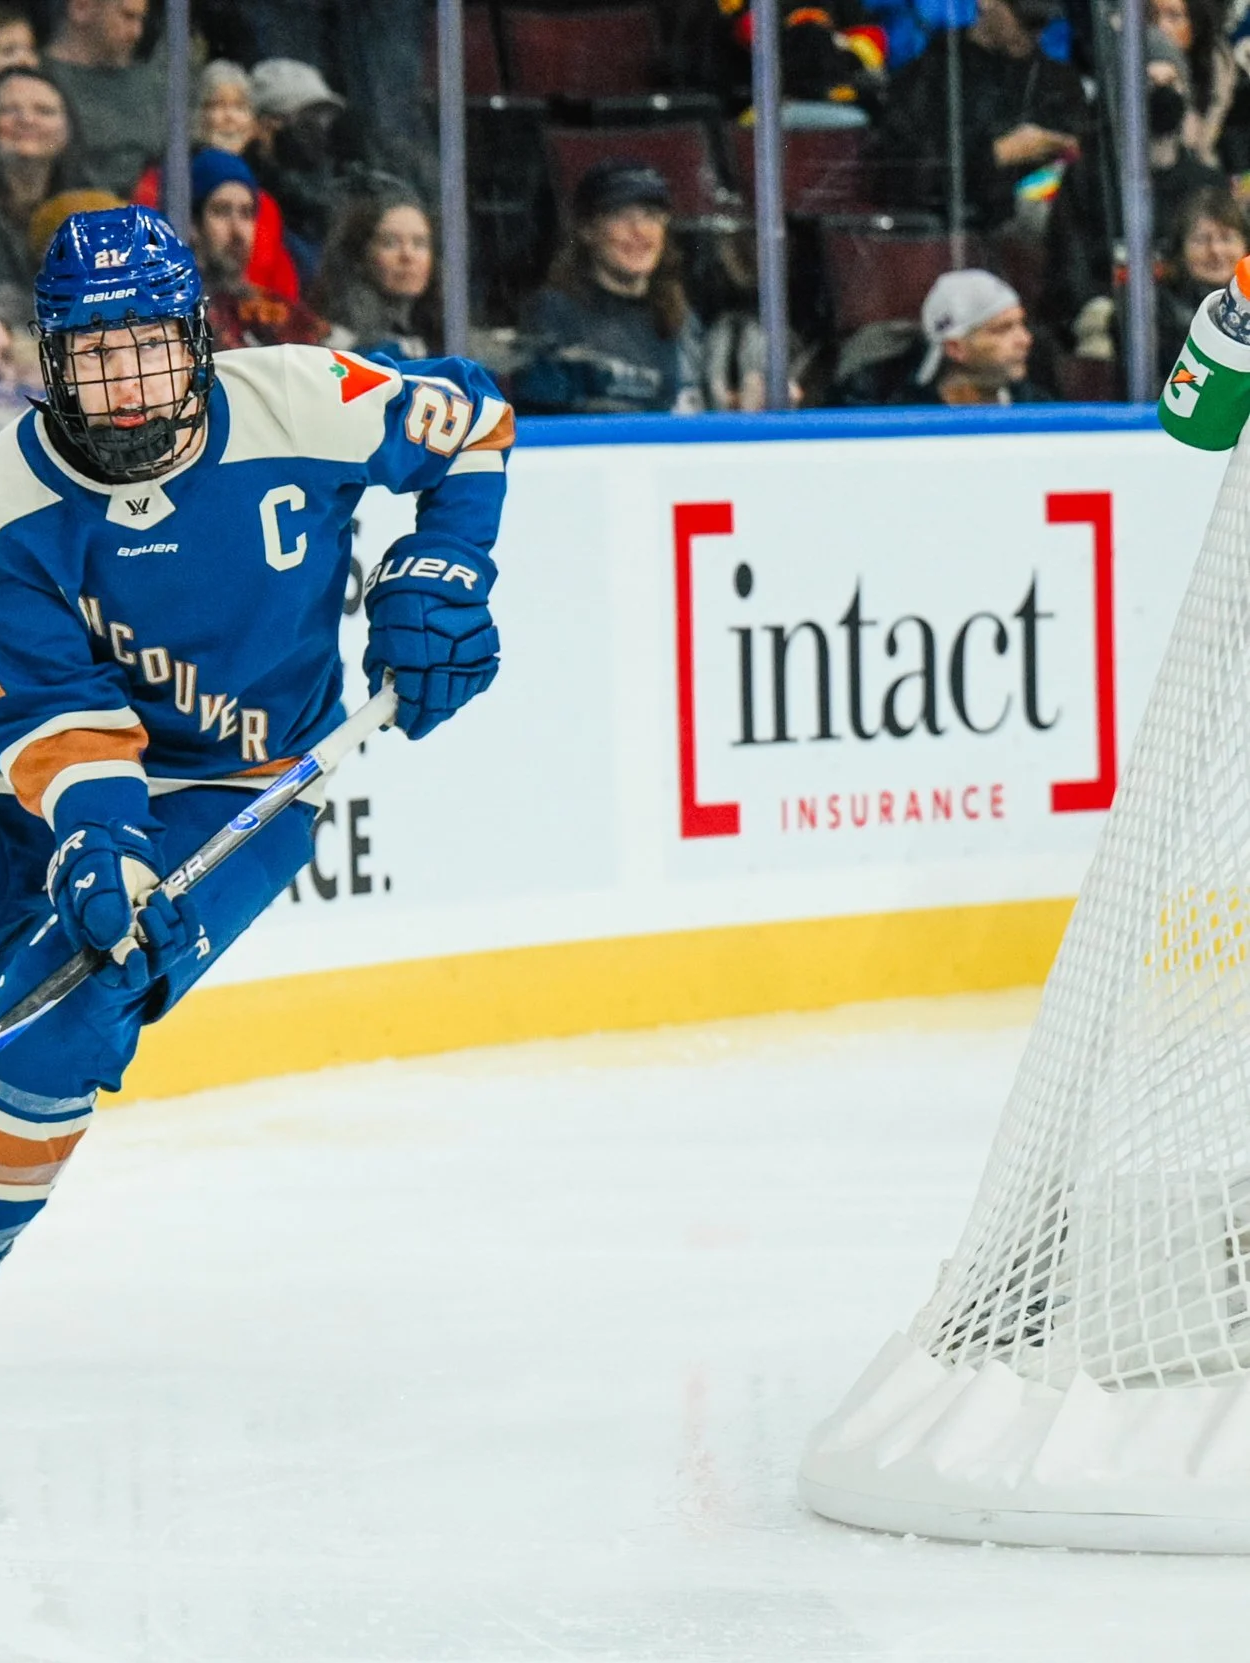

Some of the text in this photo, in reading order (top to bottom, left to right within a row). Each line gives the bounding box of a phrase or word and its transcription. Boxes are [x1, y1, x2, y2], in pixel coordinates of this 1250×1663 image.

[94, 248, 125, 269] 21
[259, 483, 308, 572] C
[729, 562, 1062, 747] intact
[781, 783, 1006, 832] INSURANCE
